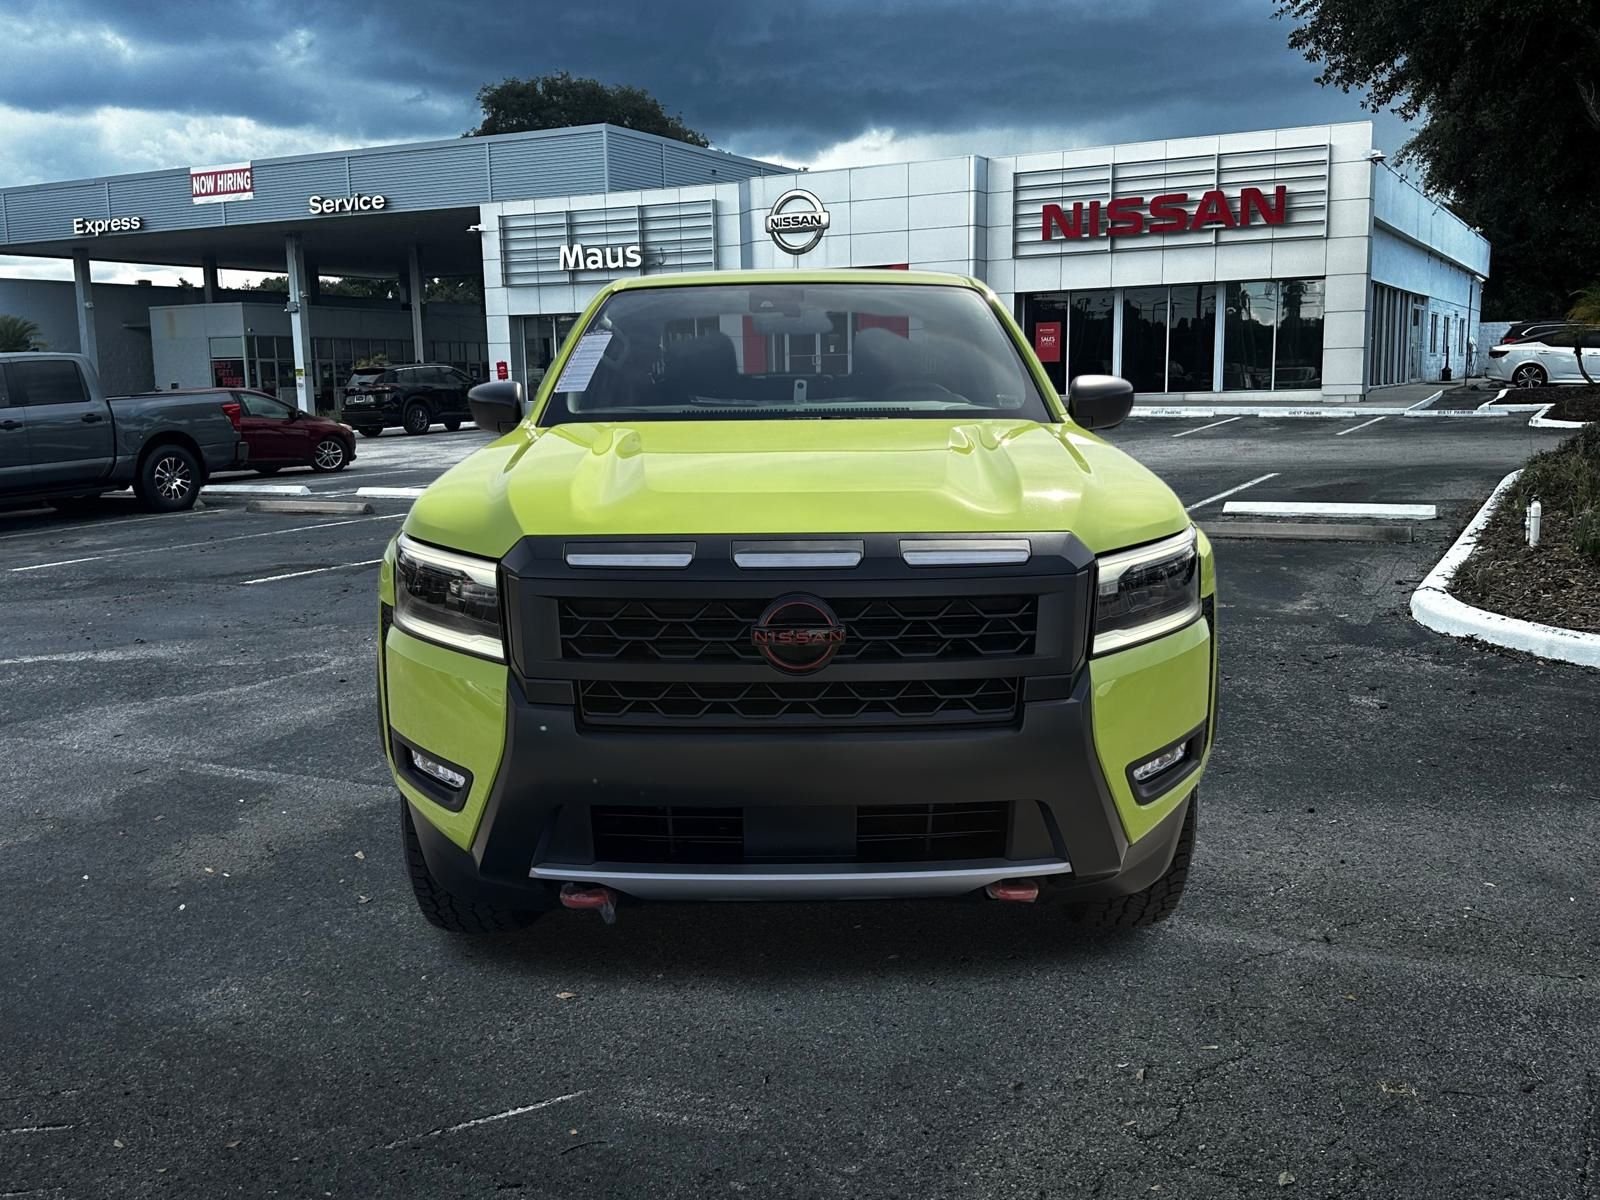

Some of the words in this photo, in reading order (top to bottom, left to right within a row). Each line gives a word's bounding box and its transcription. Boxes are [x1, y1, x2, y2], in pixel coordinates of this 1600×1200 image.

[192, 174, 216, 195] NOW
[217, 171, 251, 193] HIRING
[308, 192, 386, 215] Service
[1041, 184, 1288, 241] NISSAN
[73, 216, 141, 237] Express
[770, 214, 822, 229] NISSAN
[559, 243, 642, 271] Maus
[753, 630, 843, 643] NISSAN
